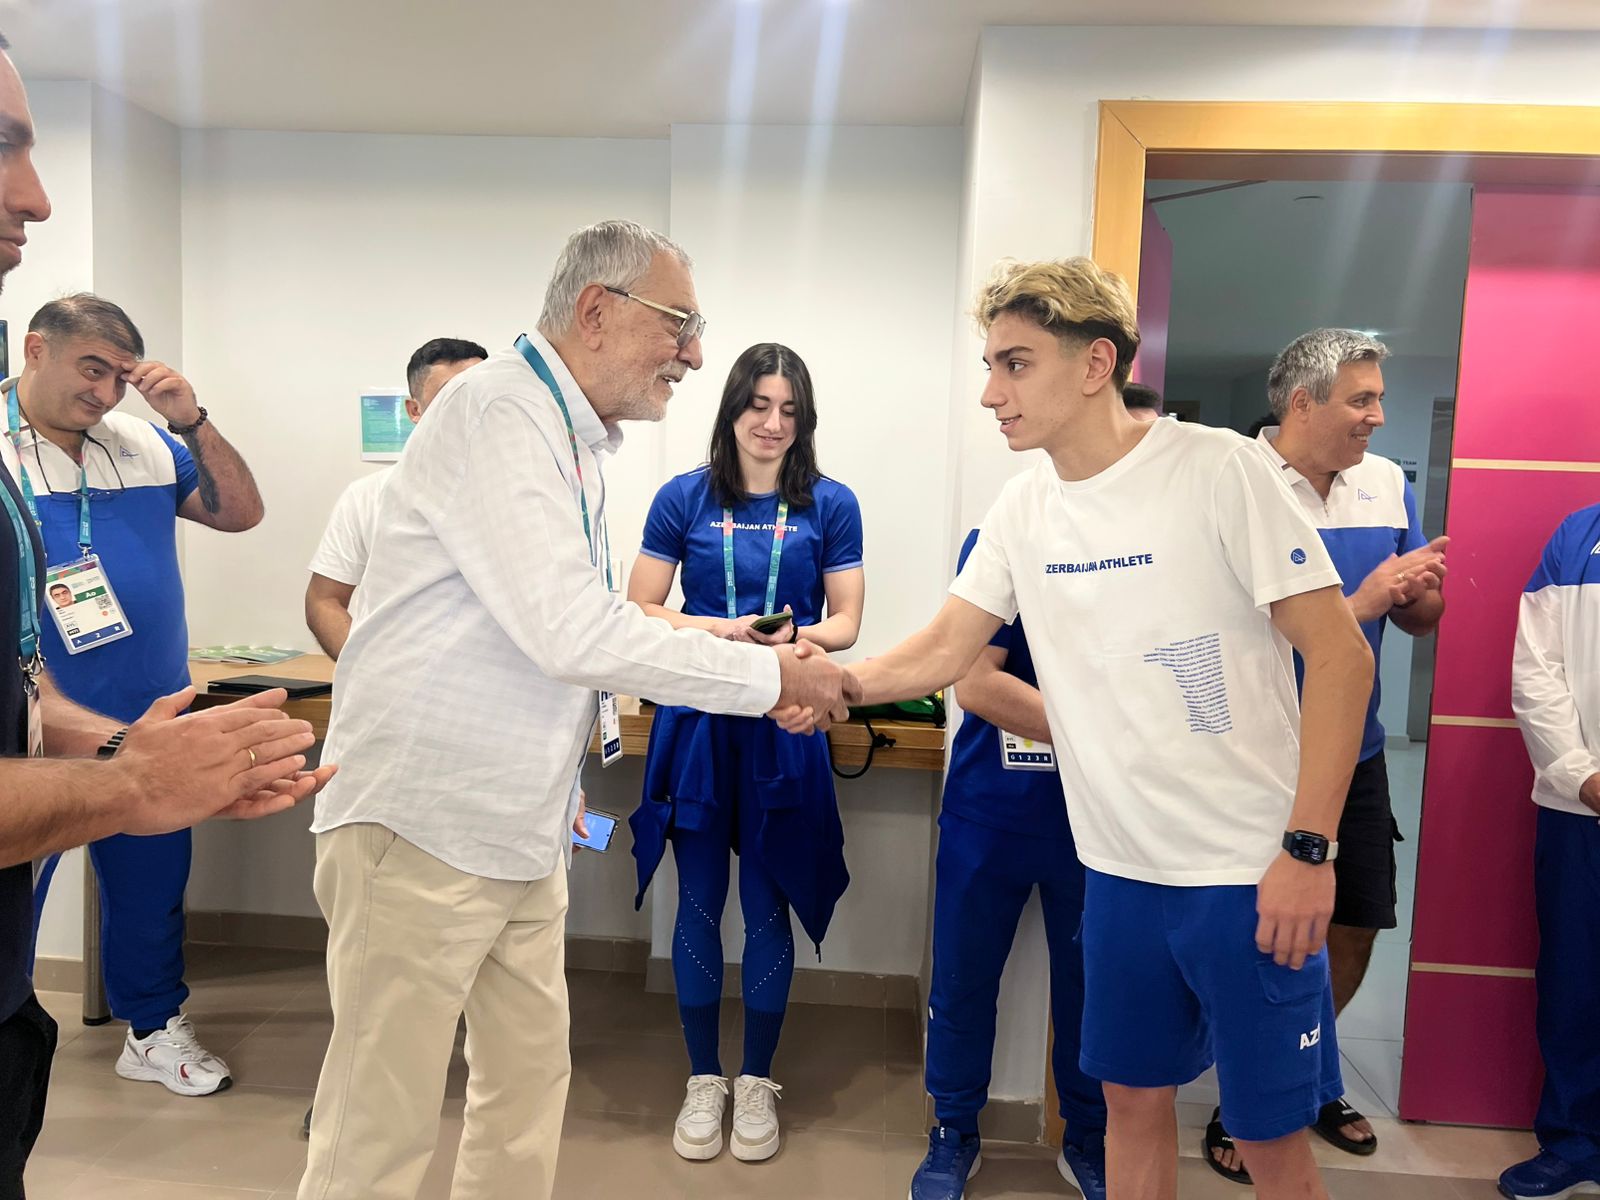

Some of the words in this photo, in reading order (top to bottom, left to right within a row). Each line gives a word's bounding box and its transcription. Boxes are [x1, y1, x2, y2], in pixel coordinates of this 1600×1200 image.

[762, 524, 798, 532] ATHETE
[1099, 554, 1153, 570] ATHLETE
[1300, 1022, 1320, 1050] AZ
